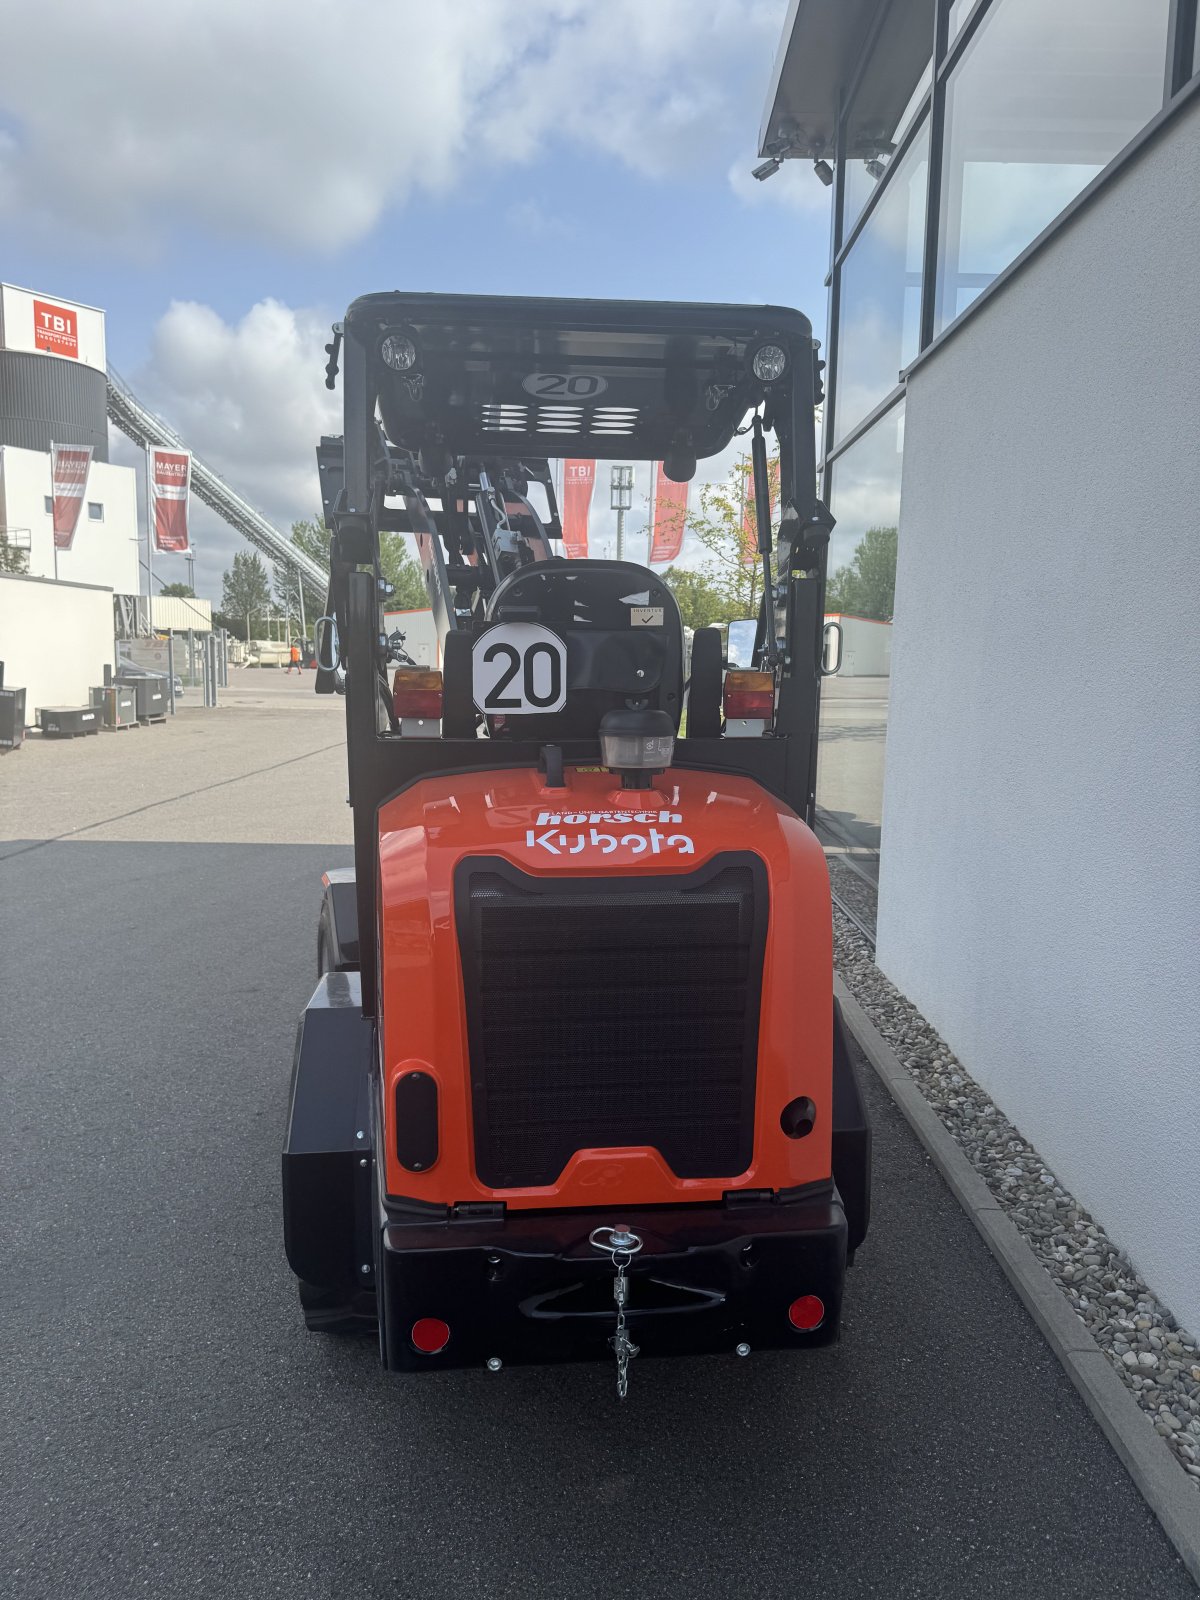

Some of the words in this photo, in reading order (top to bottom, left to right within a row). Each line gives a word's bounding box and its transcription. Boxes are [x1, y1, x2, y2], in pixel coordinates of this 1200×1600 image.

[41, 312, 71, 334] TBI
[535, 375, 599, 395] 20
[156, 462, 187, 472] MAYER
[569, 466, 591, 477] TBI
[483, 642, 562, 709] 20
[536, 811, 683, 826] horsch
[526, 828, 695, 855] Kubota
